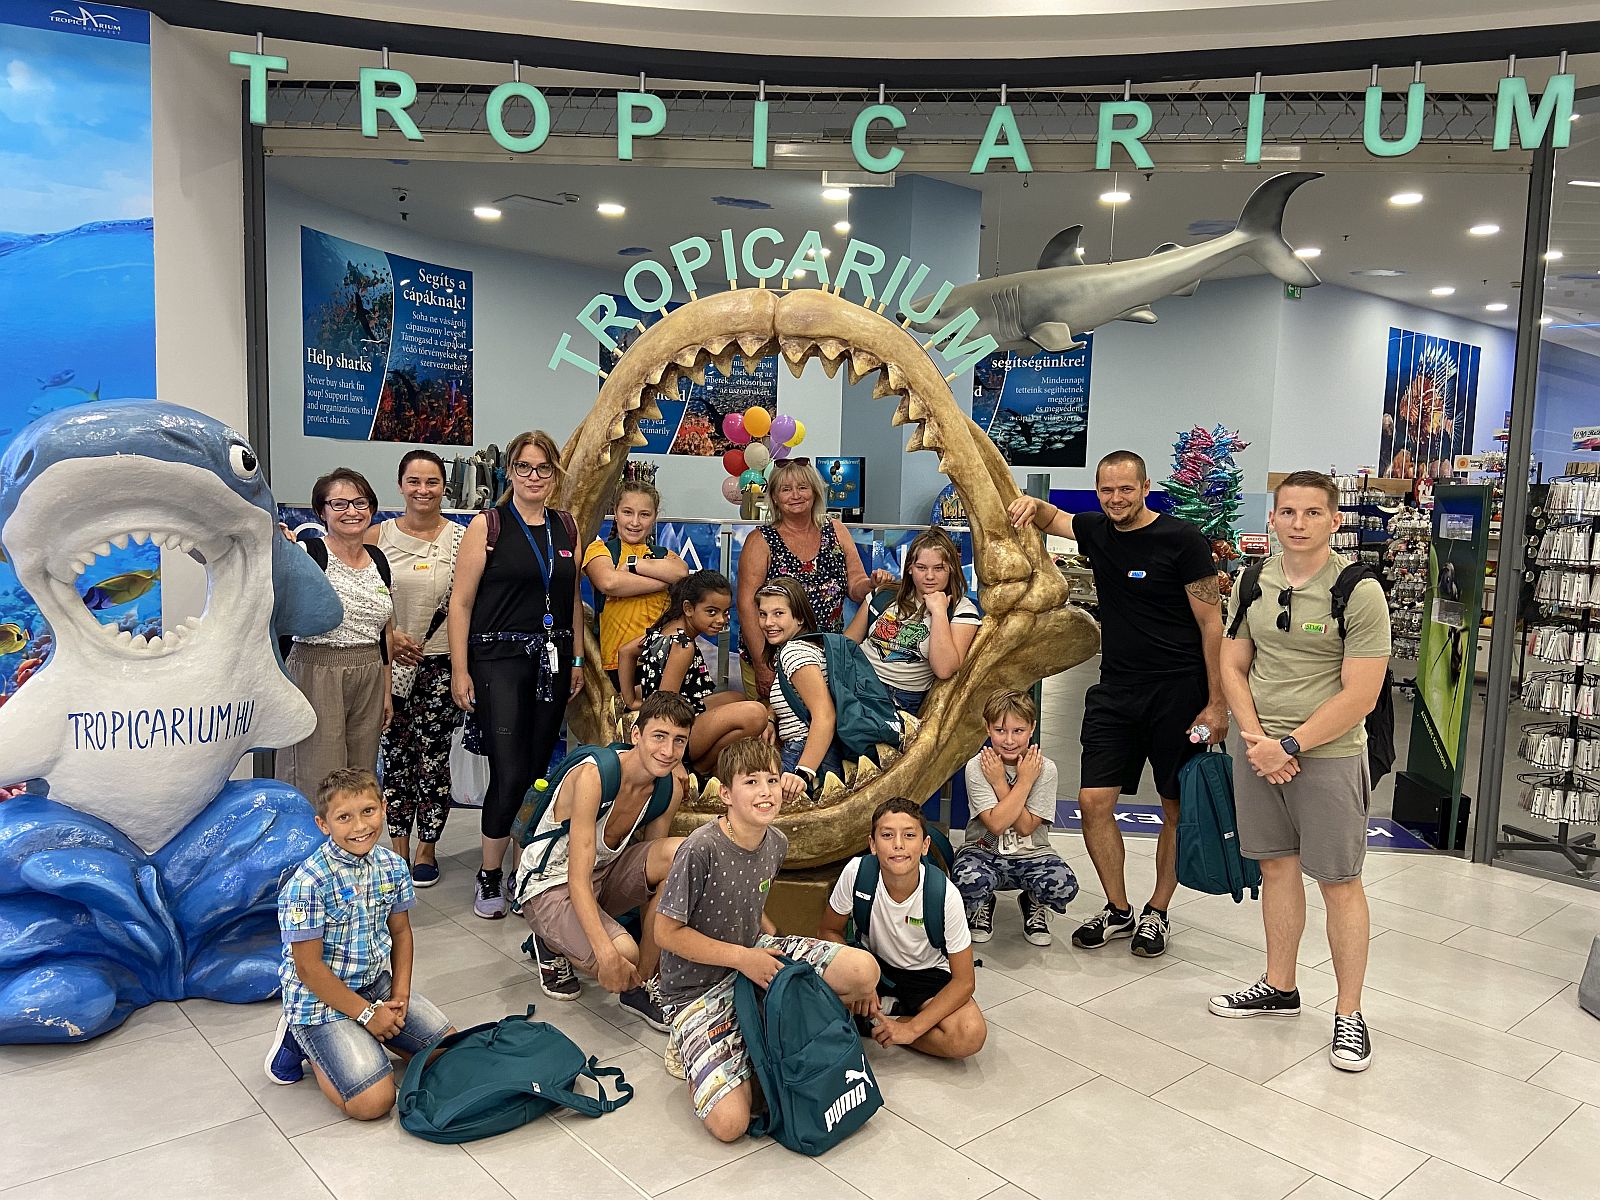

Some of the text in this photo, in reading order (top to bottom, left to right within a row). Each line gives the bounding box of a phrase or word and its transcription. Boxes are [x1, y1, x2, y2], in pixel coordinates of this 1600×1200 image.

[49, 7, 121, 31] TROPICARIUM
[83, 26, 120, 35] BUDAPEST
[229, 49, 1576, 174] TROPICARIUM
[418, 268, 467, 290] Segíts a
[403, 287, 466, 310] cápáknak!
[548, 227, 999, 376] TROPICARIUM
[412, 310, 467, 329] Soha ne vásárolj
[405, 322, 443, 338] cápauszony
[401, 331, 433, 345] Támogasd
[440, 339, 467, 350] cápákat
[306, 346, 373, 372] Help sharks
[418, 347, 458, 360] törvényeket
[991, 354, 1086, 372] segítségünkre!
[732, 367, 747, 377] lnek
[306, 373, 365, 391] Never buy shark fin
[735, 378, 772, 388] elsősorban
[1041, 376, 1085, 386] Mindennapi
[307, 388, 364, 403] soup! Support laws
[1015, 385, 1085, 396] tetteink segíthetnek
[306, 400, 374, 416] and organizations that
[1047, 395, 1084, 405] megőrizni
[1044, 404, 1084, 415] megvédeni
[306, 415, 351, 425] protect sharks.
[652, 418, 667, 427] year
[68, 700, 255, 750] TROPICARIUM.HU
[1068, 809, 1164, 826] EXT
[824, 1081, 867, 1133] PUMA
